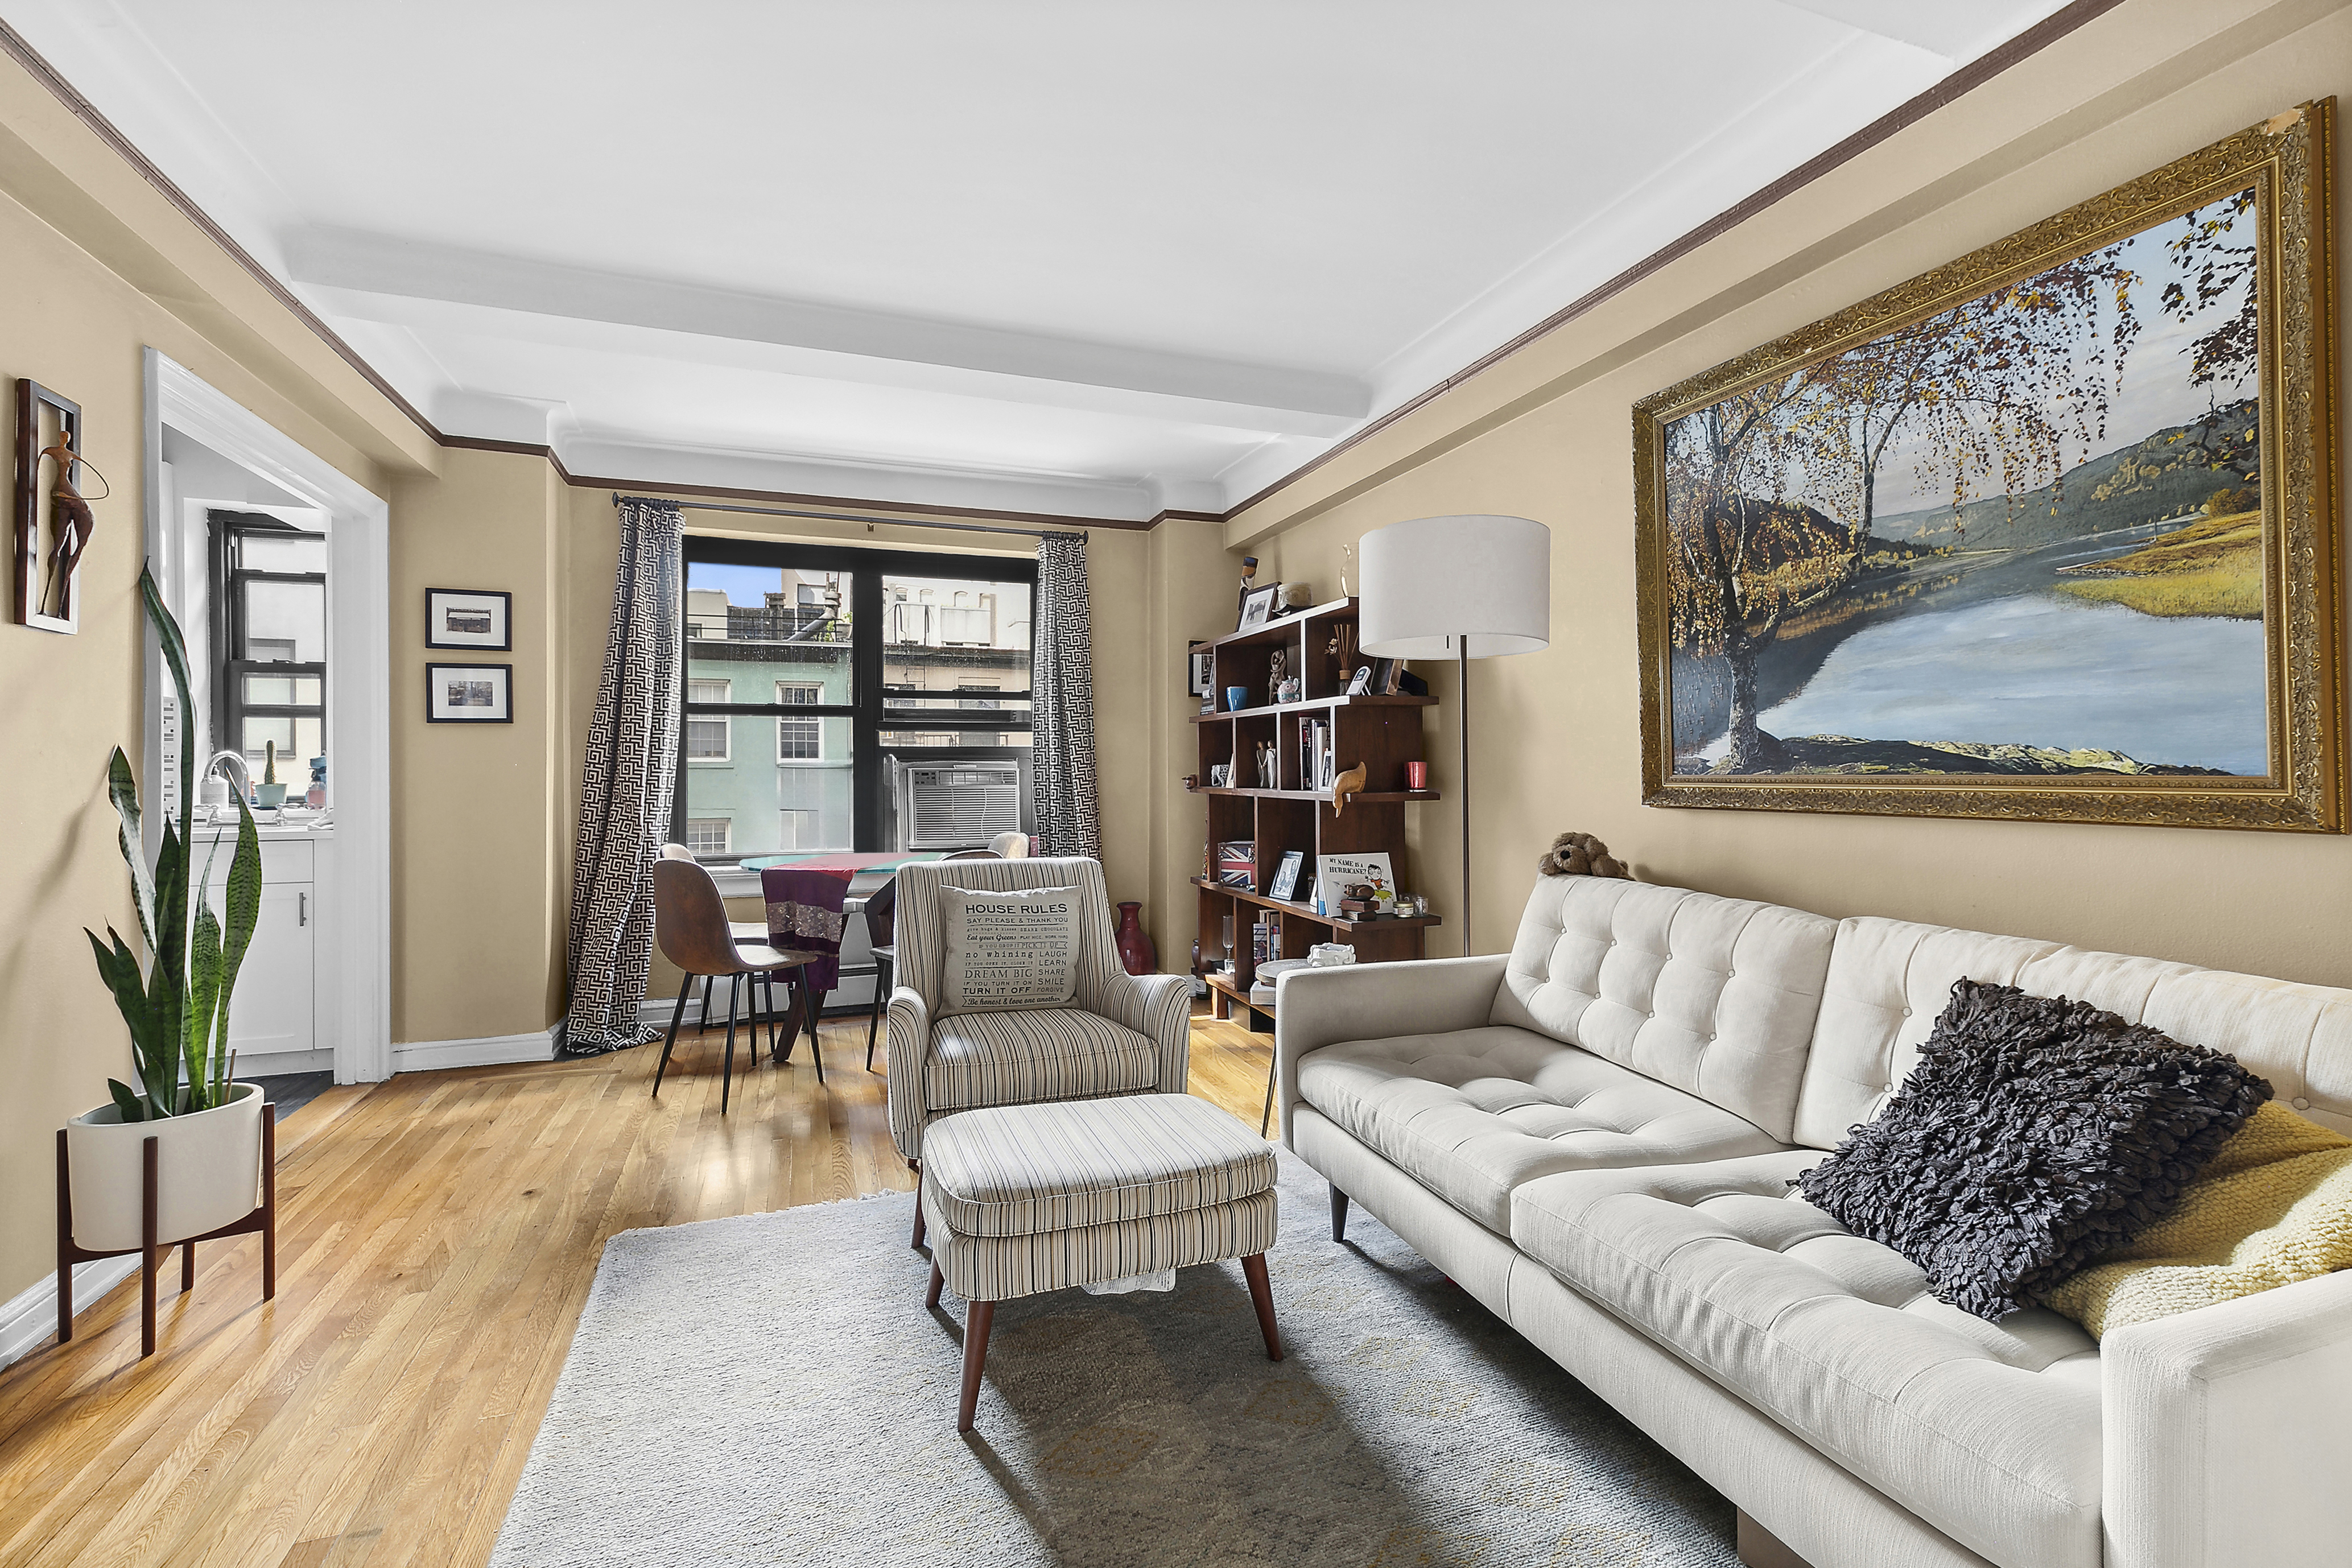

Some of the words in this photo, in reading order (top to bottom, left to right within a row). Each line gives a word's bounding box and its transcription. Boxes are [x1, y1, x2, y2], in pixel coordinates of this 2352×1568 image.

[965, 905, 1016, 914] HOUSE
[1020, 903, 1067, 914] RULES
[964, 969, 1008, 979] DREAM
[1014, 969, 1033, 978] BIG
